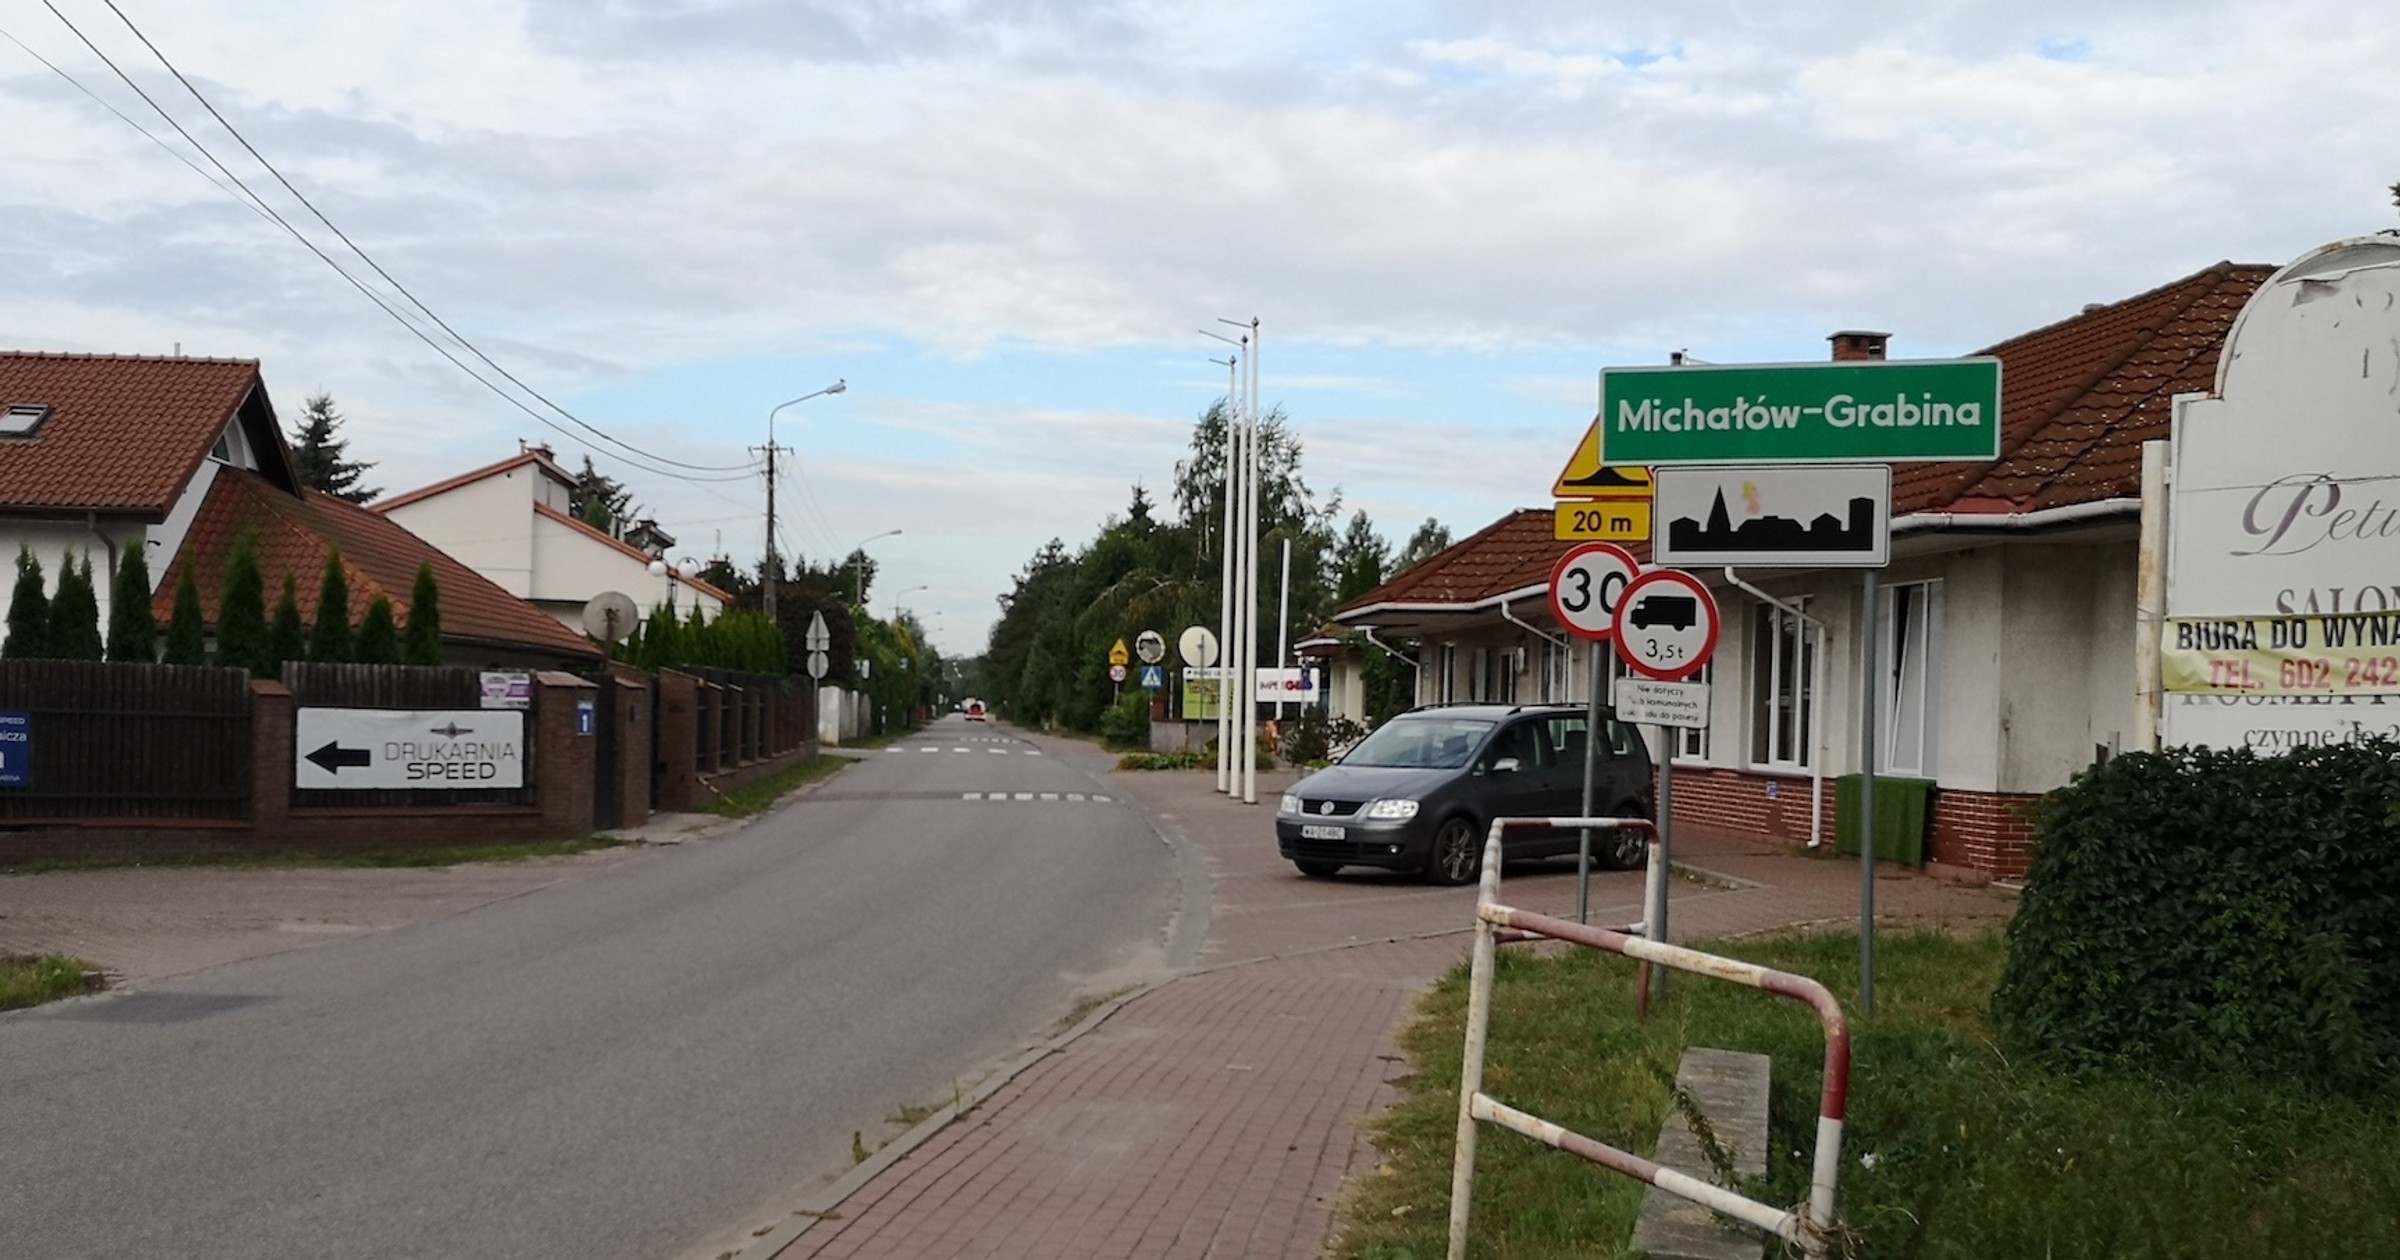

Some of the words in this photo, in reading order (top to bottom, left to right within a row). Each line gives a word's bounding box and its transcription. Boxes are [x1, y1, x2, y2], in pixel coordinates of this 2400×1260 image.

[1617, 393, 1981, 433] Michałów-Grabina
[1572, 510, 1602, 532] 20
[1611, 518, 1631, 532] m
[1562, 567, 1629, 615] 30
[2176, 621, 2258, 650] BIURA
[2271, 618, 2308, 649] DO
[2209, 659, 2265, 689] TEL.
[2279, 658, 2331, 689] 602
[2345, 656, 2400, 688] 242
[1637, 684, 1650, 694] Nie
[1652, 686, 1684, 698] dotyczy
[1646, 697, 1698, 711] komunalnych
[385, 742, 516, 761] DRUKARNIA
[2243, 728, 2336, 758] czynne
[407, 762, 496, 780] SPEED
